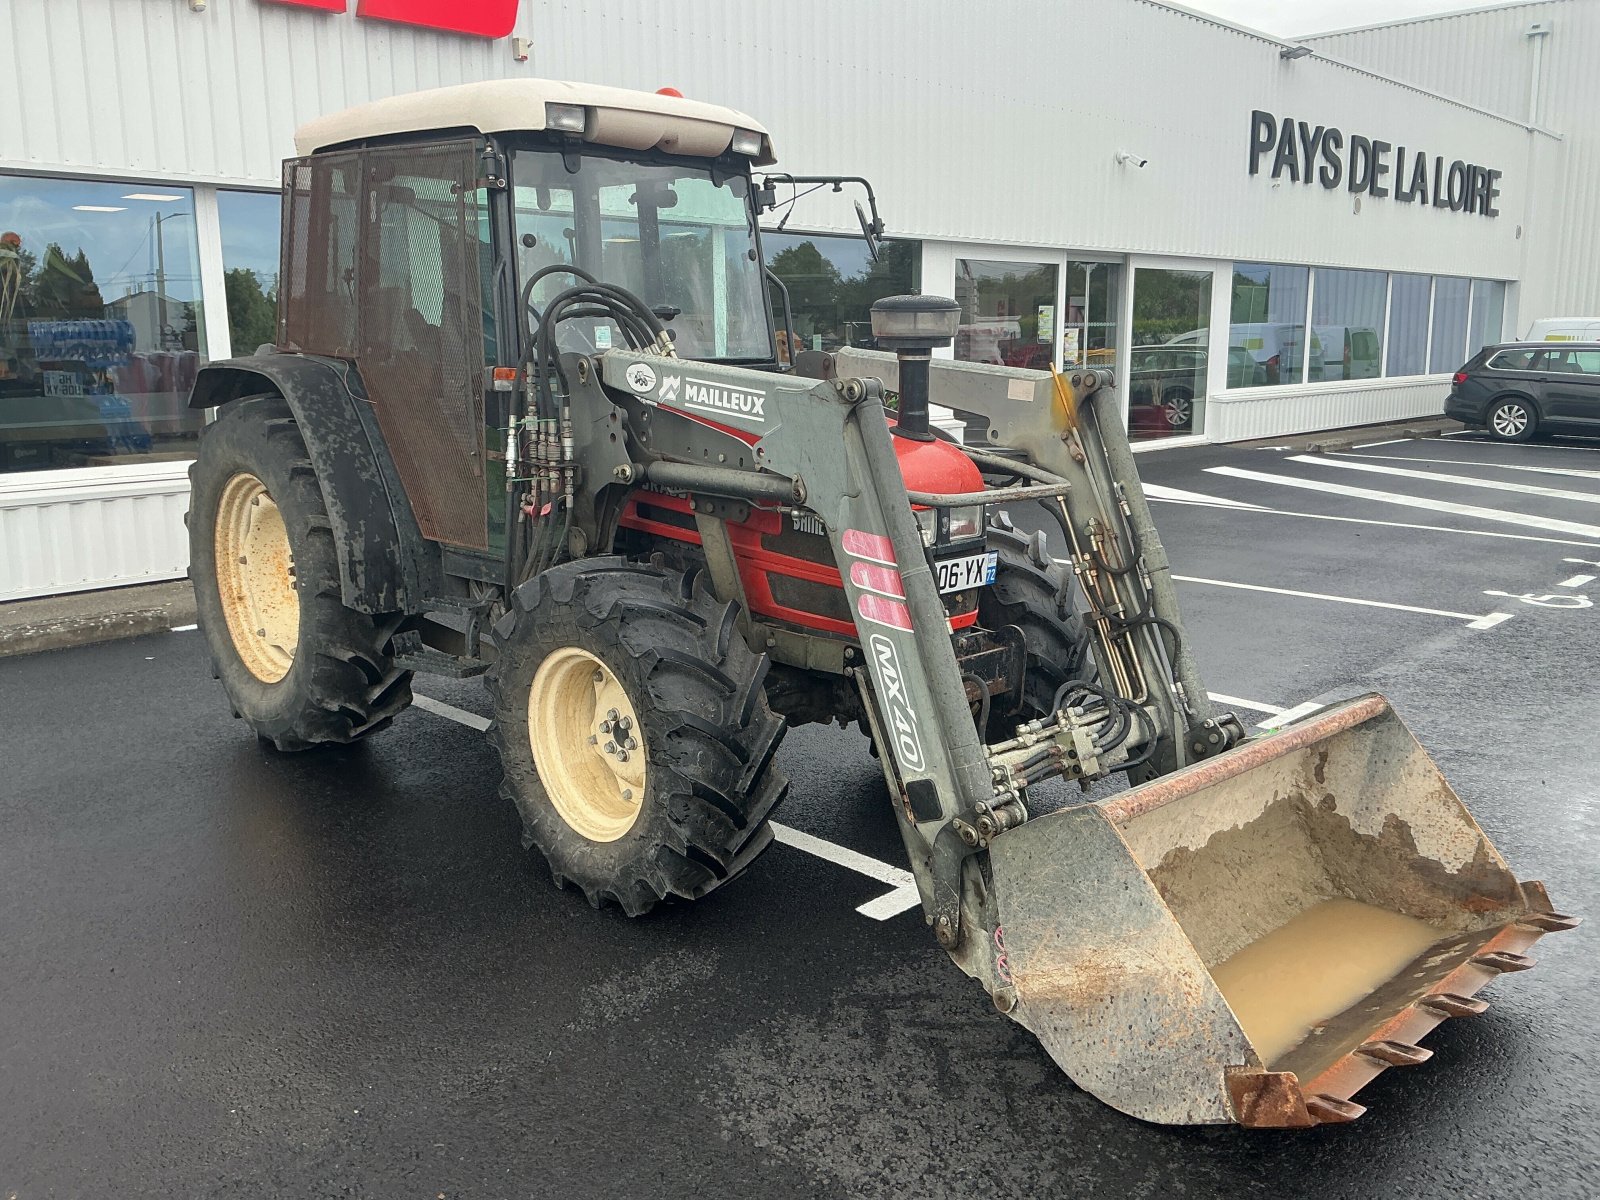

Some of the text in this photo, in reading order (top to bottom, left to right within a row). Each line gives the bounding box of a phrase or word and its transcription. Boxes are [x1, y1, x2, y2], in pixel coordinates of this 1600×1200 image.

[1249, 110, 1502, 217] PAYS DE LA LOIRE
[685, 383, 765, 416] MAILLEUX
[987, 569, 996, 582] 72
